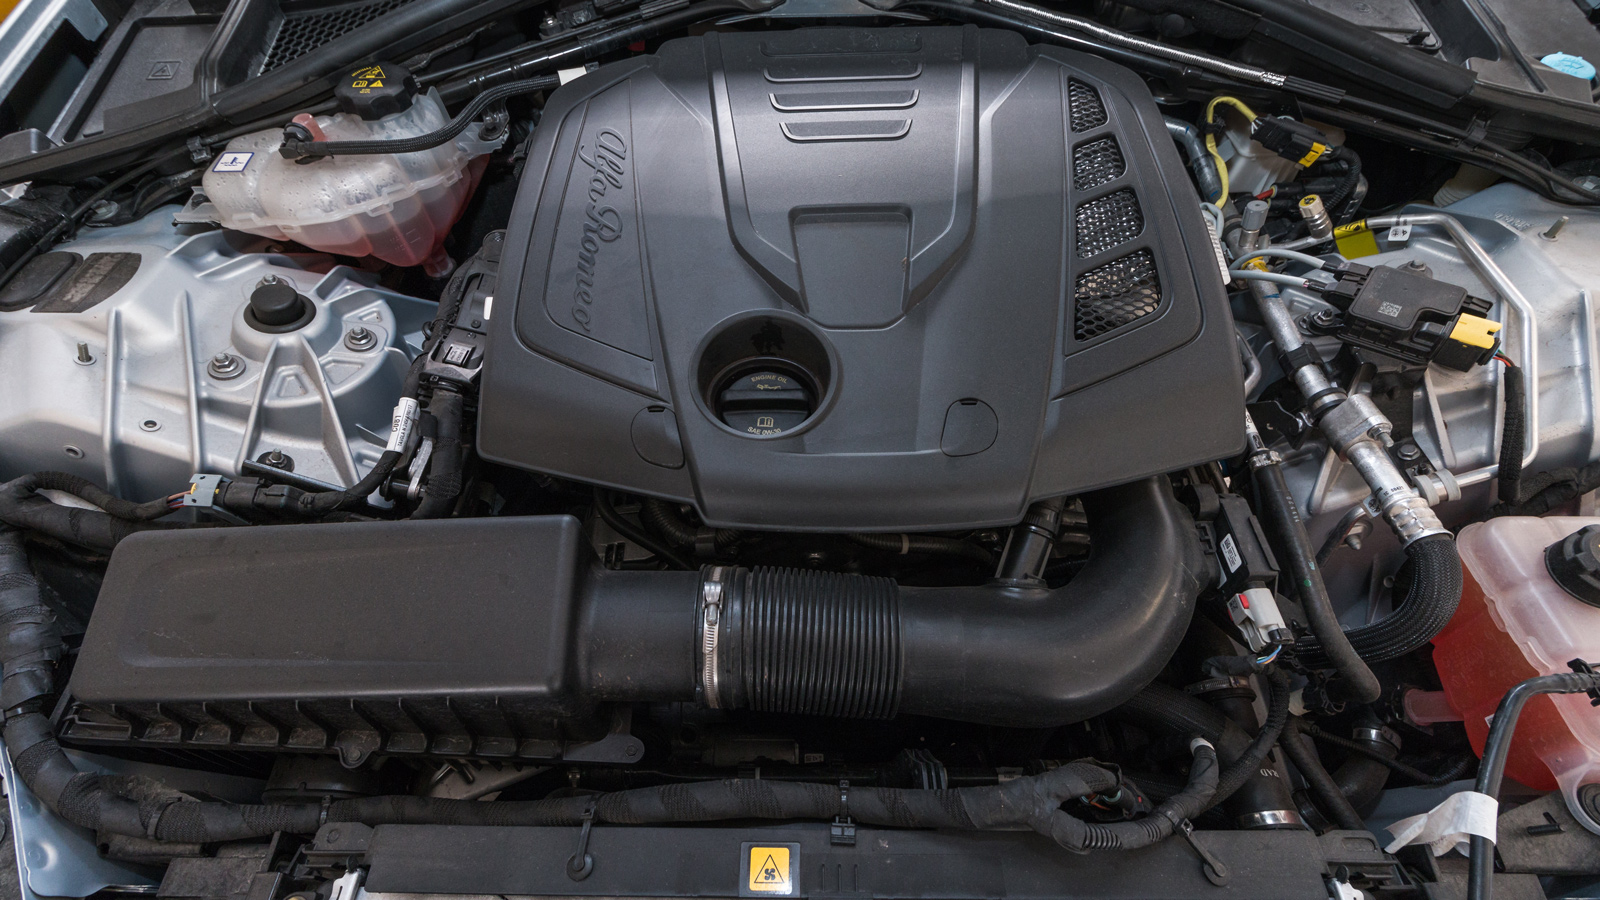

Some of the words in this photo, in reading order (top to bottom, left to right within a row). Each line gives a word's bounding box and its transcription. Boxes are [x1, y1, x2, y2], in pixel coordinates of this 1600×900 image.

[578, 127, 627, 202] Alfa
[572, 203, 623, 331] Romeo
[777, 376, 788, 384] OIL
[748, 426, 761, 435] SAE
